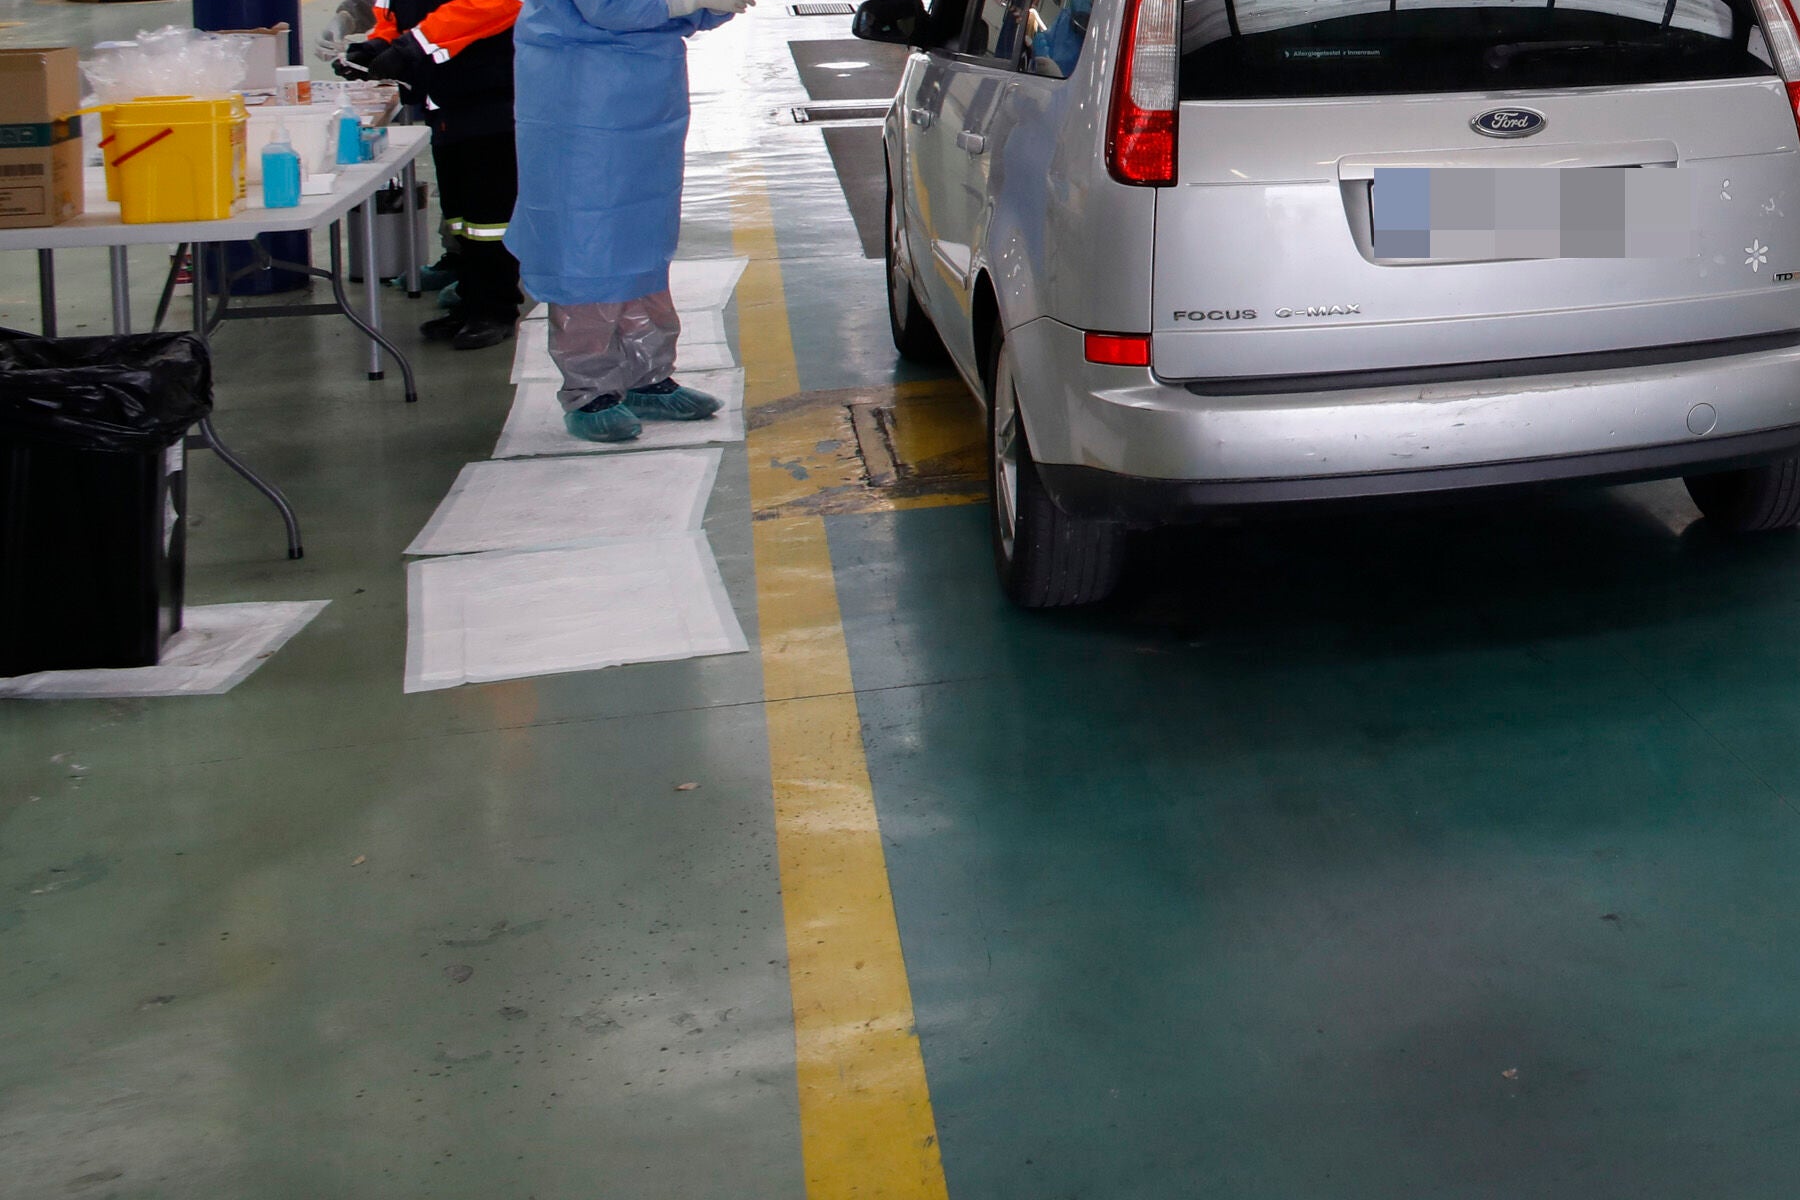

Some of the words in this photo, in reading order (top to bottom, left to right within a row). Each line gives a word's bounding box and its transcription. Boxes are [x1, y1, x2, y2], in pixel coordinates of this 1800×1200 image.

[1491, 112, 1529, 129] Ford
[1173, 308, 1257, 322] FOCUS
[1274, 303, 1362, 318] C-MAX
